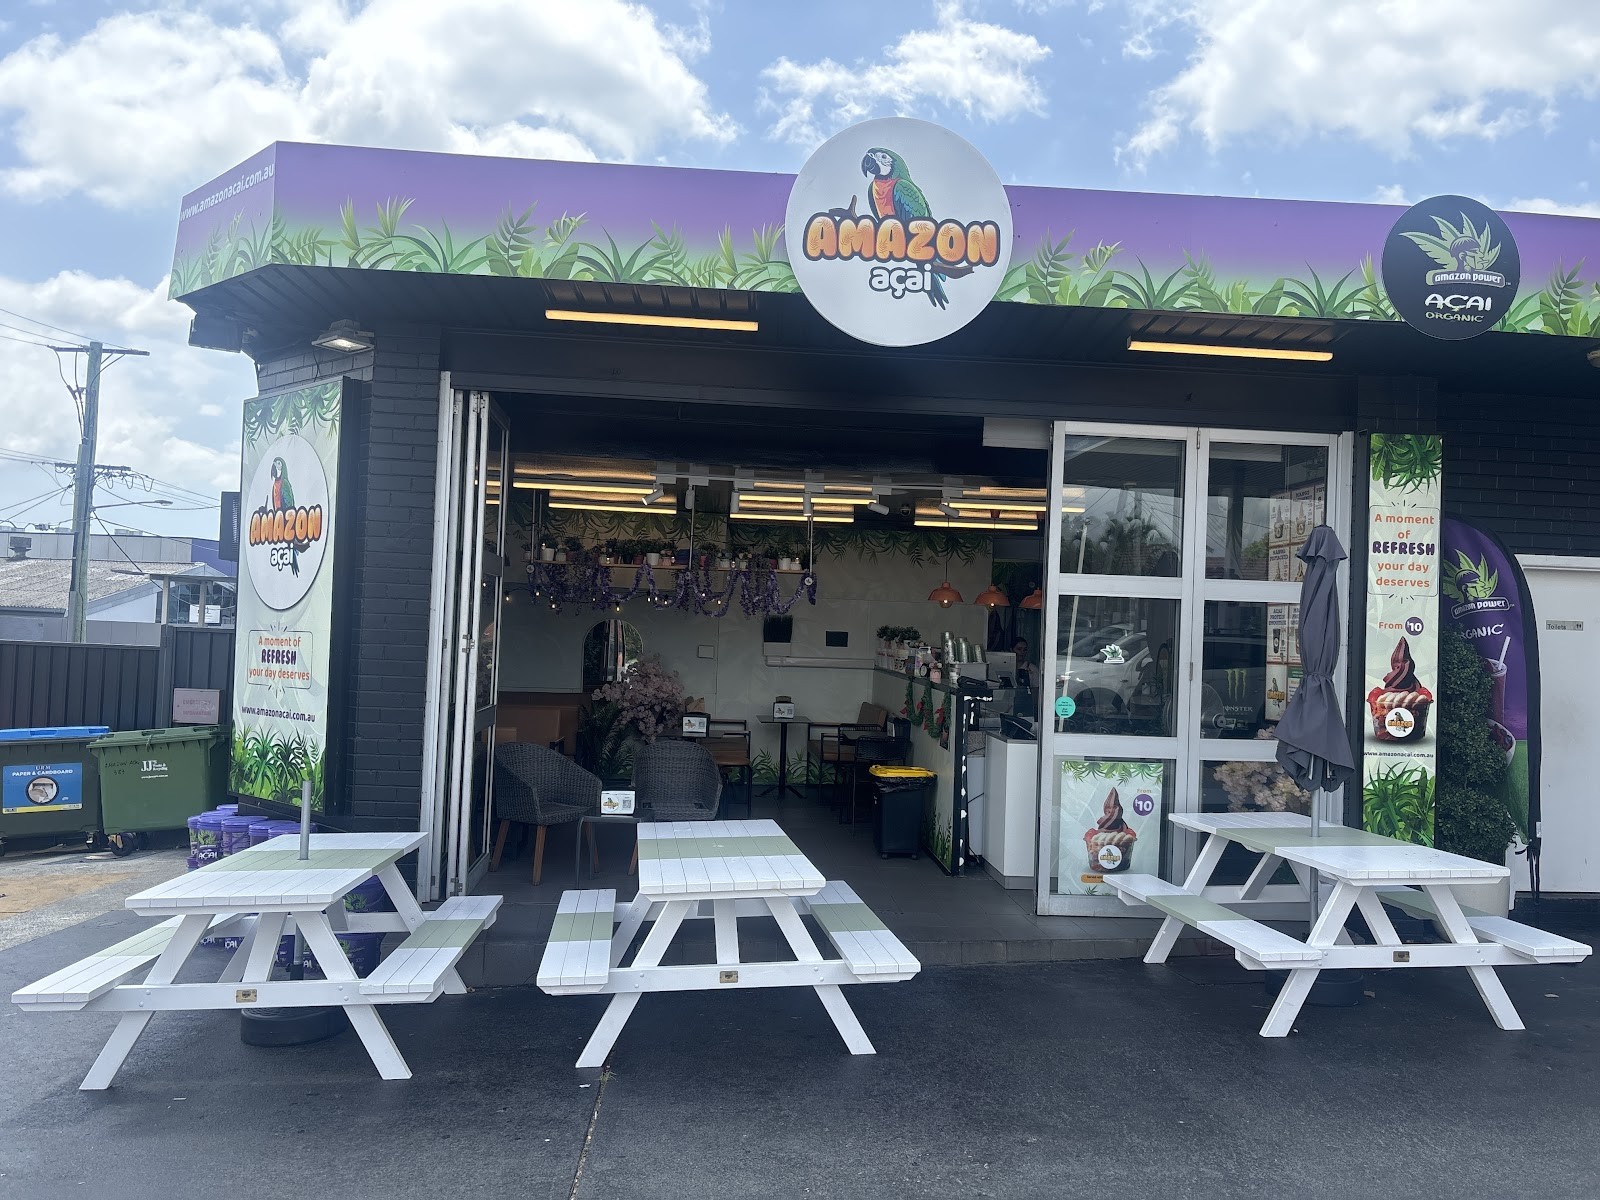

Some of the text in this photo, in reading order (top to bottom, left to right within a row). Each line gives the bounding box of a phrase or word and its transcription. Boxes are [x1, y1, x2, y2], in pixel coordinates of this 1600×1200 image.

[180, 163, 275, 221] www.amazonacai.com.au
[803, 212, 1001, 267] AMAZON
[869, 260, 932, 299] açai
[1434, 271, 1471, 282] amazon
[1472, 273, 1502, 284] power
[1424, 293, 1492, 312] AÇAI
[1425, 311, 1485, 323] ORGANIC
[249, 504, 323, 547] AMAZON
[1374, 513, 1434, 525] A moment
[1397, 529, 1411, 540] of
[1372, 541, 1435, 556] REFRESH
[270, 544, 294, 571] açai
[1377, 562, 1429, 574] your day
[1375, 577, 1430, 588] deserves
[1477, 600, 1505, 610] power
[258, 635, 301, 648] A moment of
[261, 648, 297, 665] REFRESH
[249, 667, 310, 681] your day deserves
[241, 705, 316, 723] www.amazonacai.com.au
[1364, 751, 1434, 759] www.amazonacai.com.au
